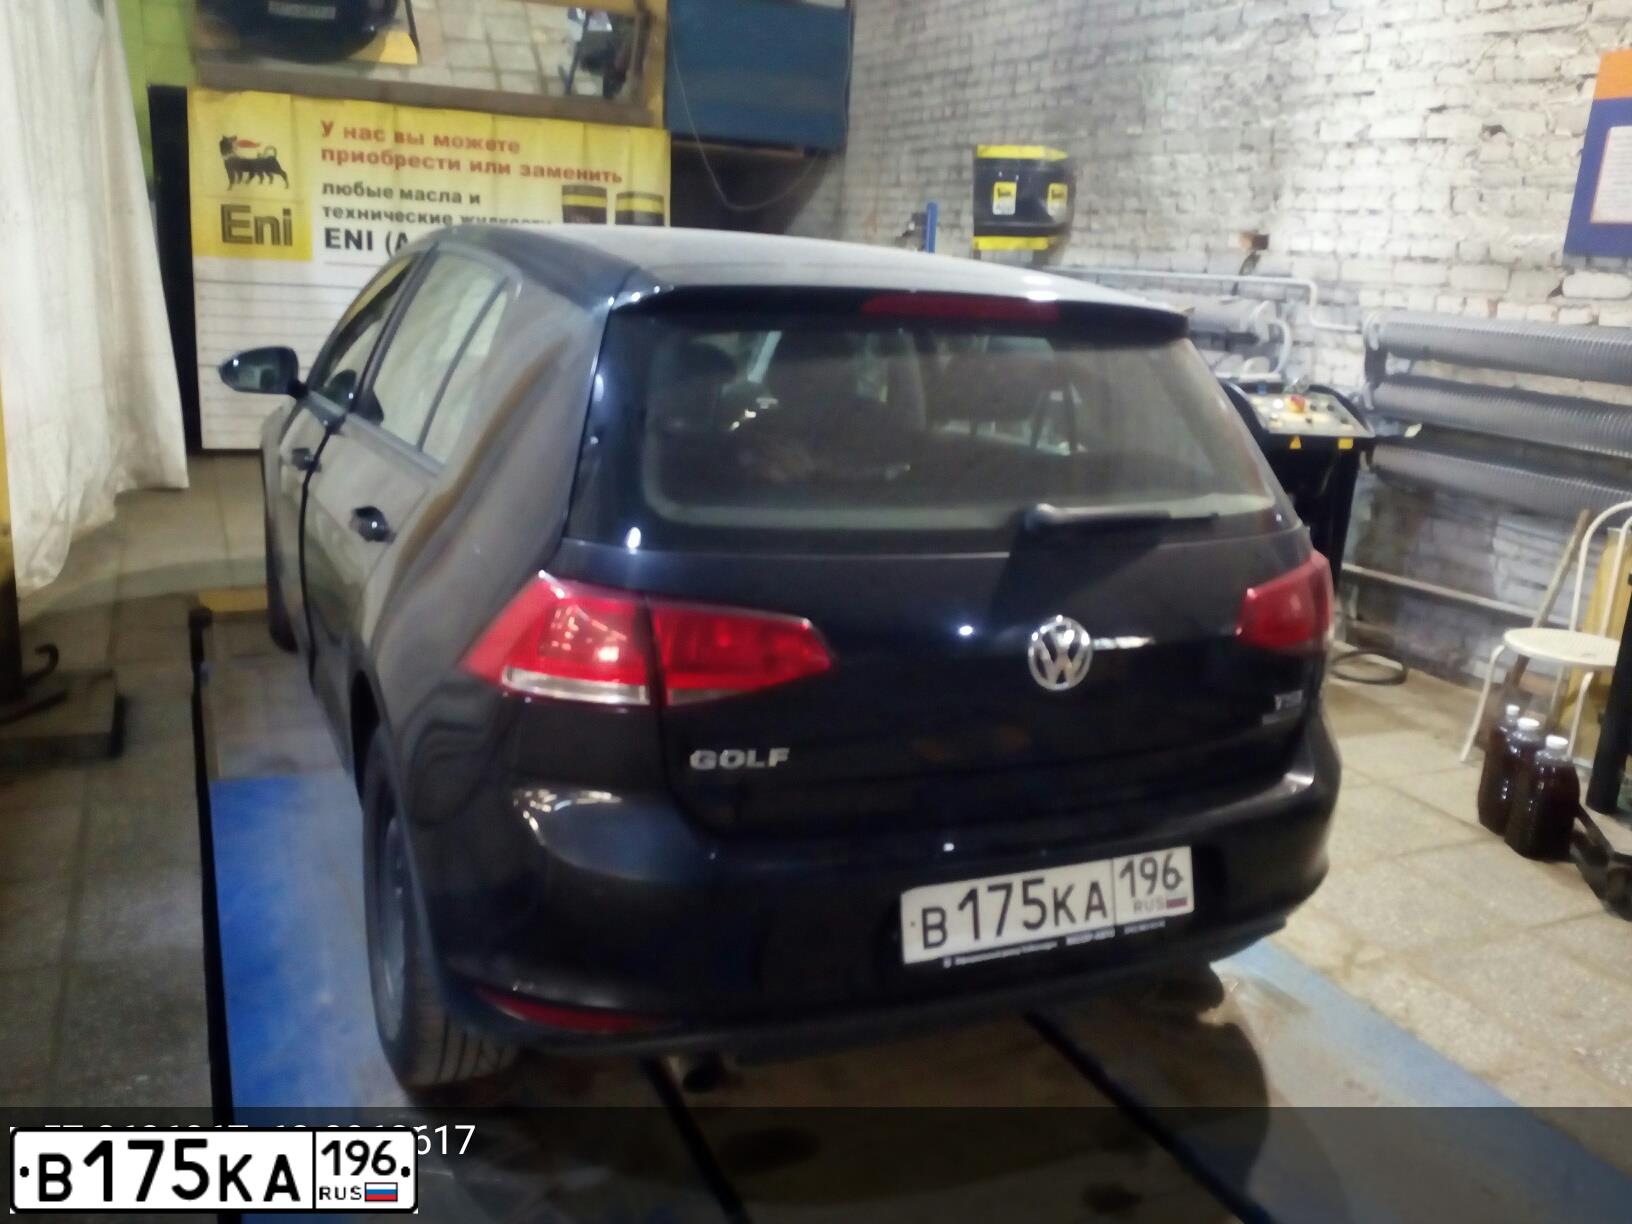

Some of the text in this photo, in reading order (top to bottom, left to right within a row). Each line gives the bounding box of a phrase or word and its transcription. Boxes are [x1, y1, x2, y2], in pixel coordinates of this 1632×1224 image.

[321, 120, 521, 155] У нас вы можете
[321, 147, 623, 184] приобрести или заменить
[321, 180, 481, 205] любые масла и
[220, 204, 294, 248] Eni
[322, 205, 453, 226] технические
[324, 227, 374, 252] ENI
[689, 746, 791, 771] GOLF
[1119, 852, 1184, 899] 196
